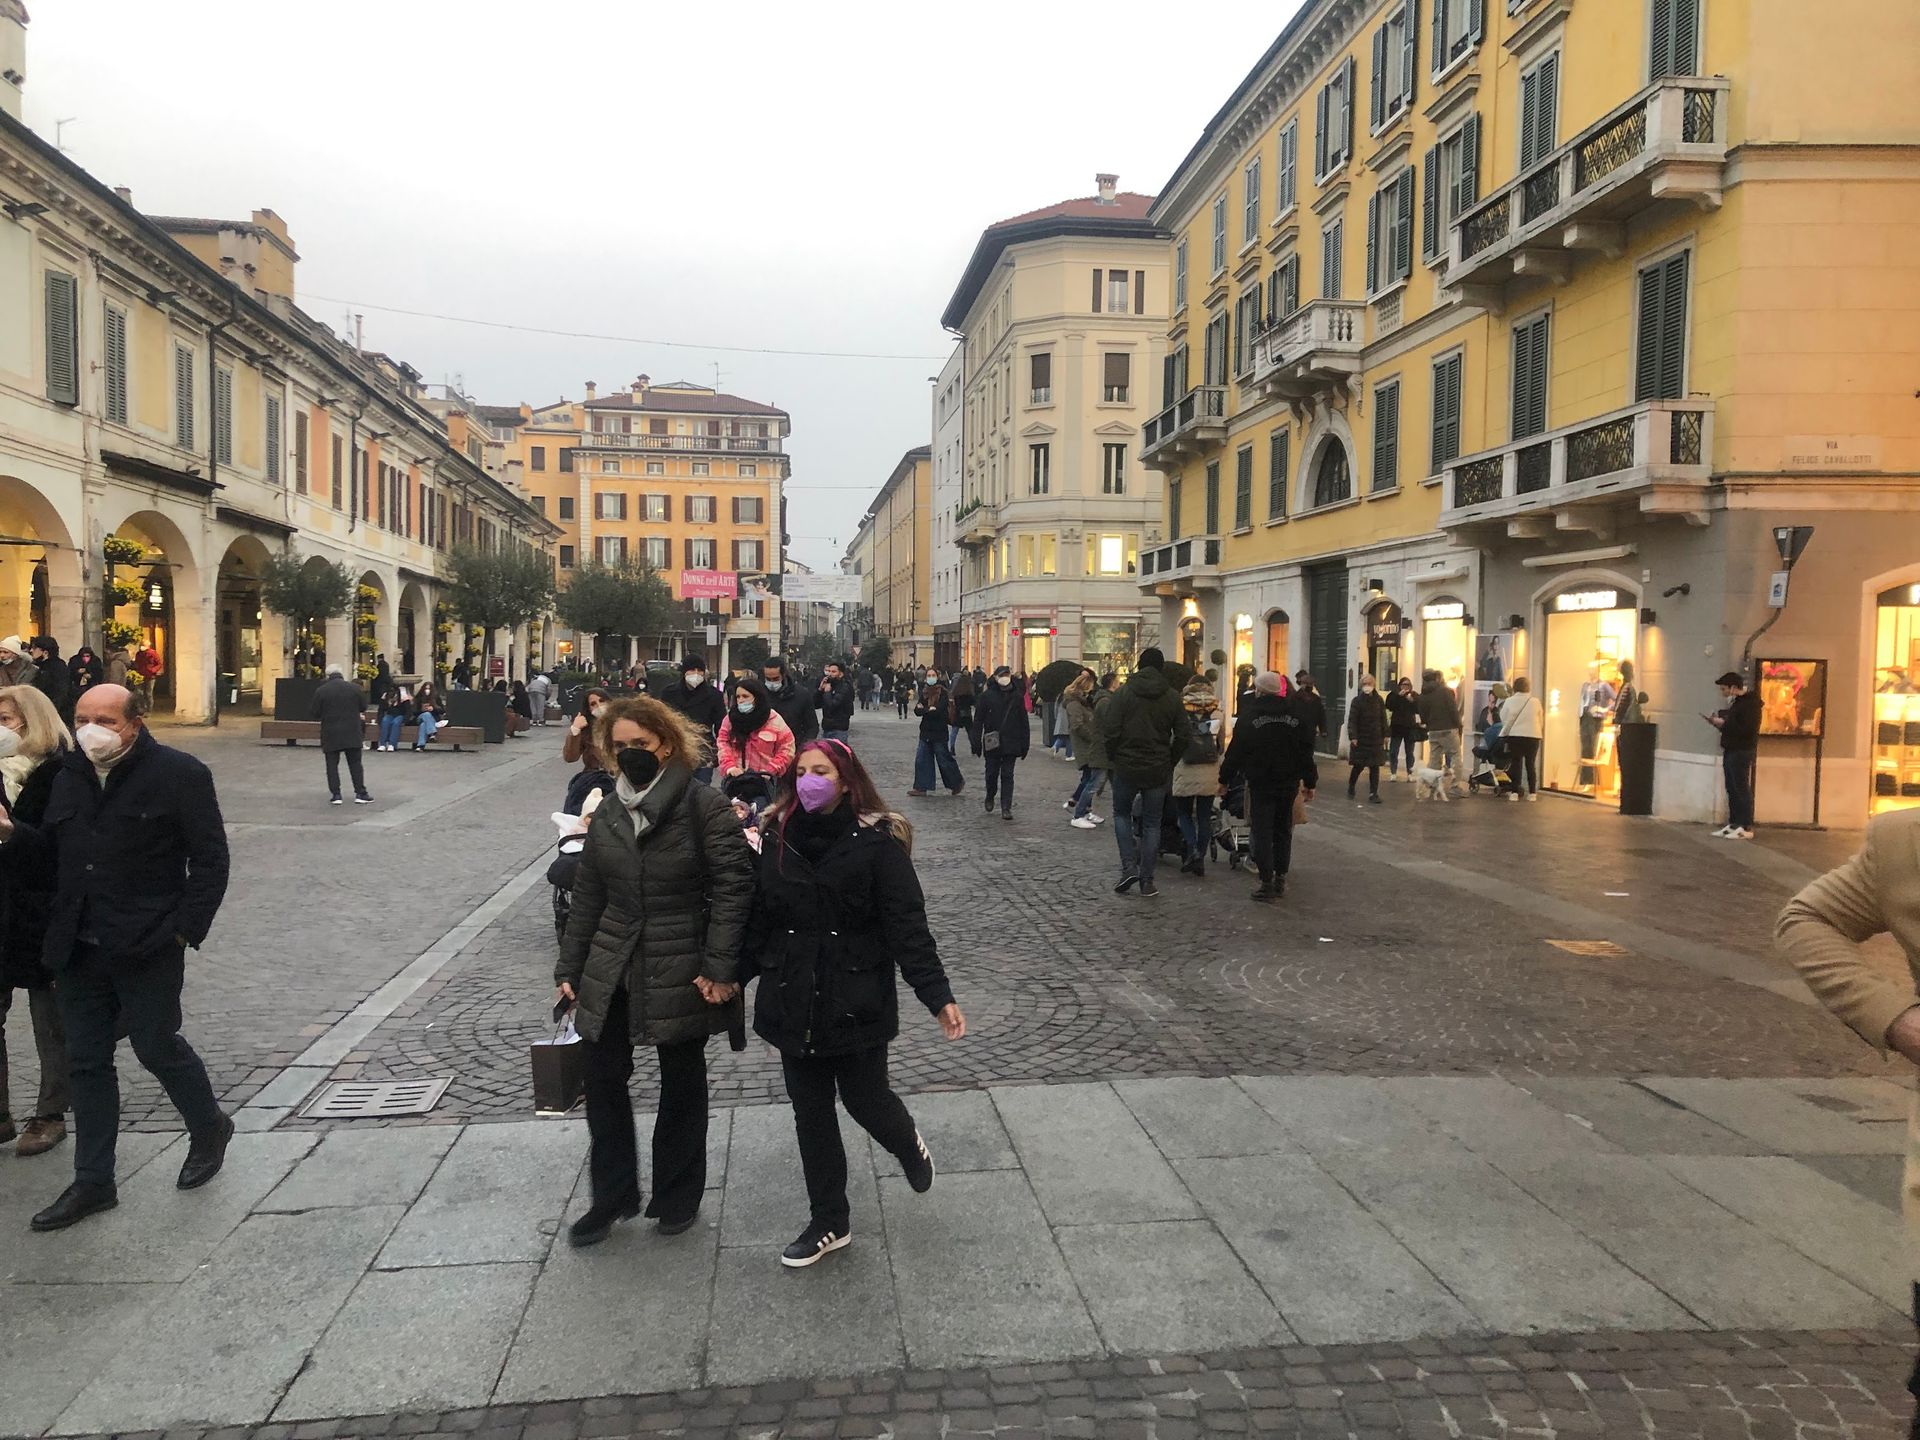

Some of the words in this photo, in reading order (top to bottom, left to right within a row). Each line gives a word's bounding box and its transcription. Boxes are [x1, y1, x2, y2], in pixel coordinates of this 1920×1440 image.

[1826, 440, 1839, 449] VIA
[1791, 455, 1819, 465] FELICE
[1824, 455, 1872, 465] CAVALLOTTI
